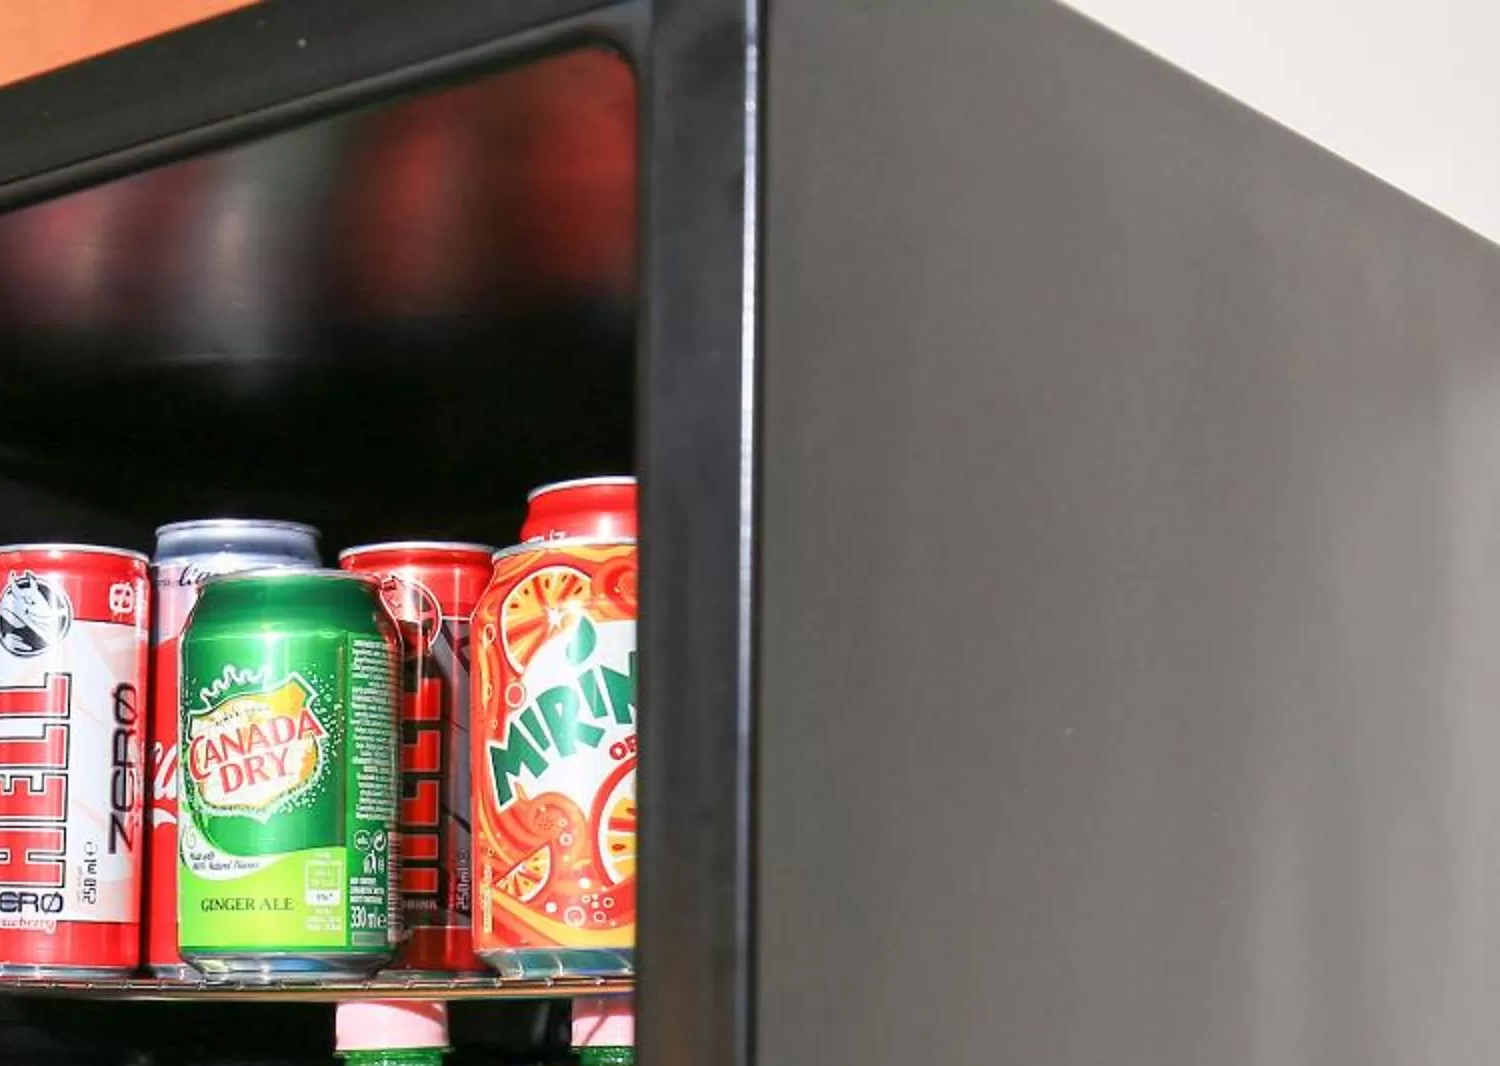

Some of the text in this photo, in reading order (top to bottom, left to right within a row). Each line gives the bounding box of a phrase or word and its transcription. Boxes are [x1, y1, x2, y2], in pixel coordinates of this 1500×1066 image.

[188, 708, 324, 781] CANADA
[219, 747, 290, 795] DRY
[201, 897, 294, 912] GINGER ALE
